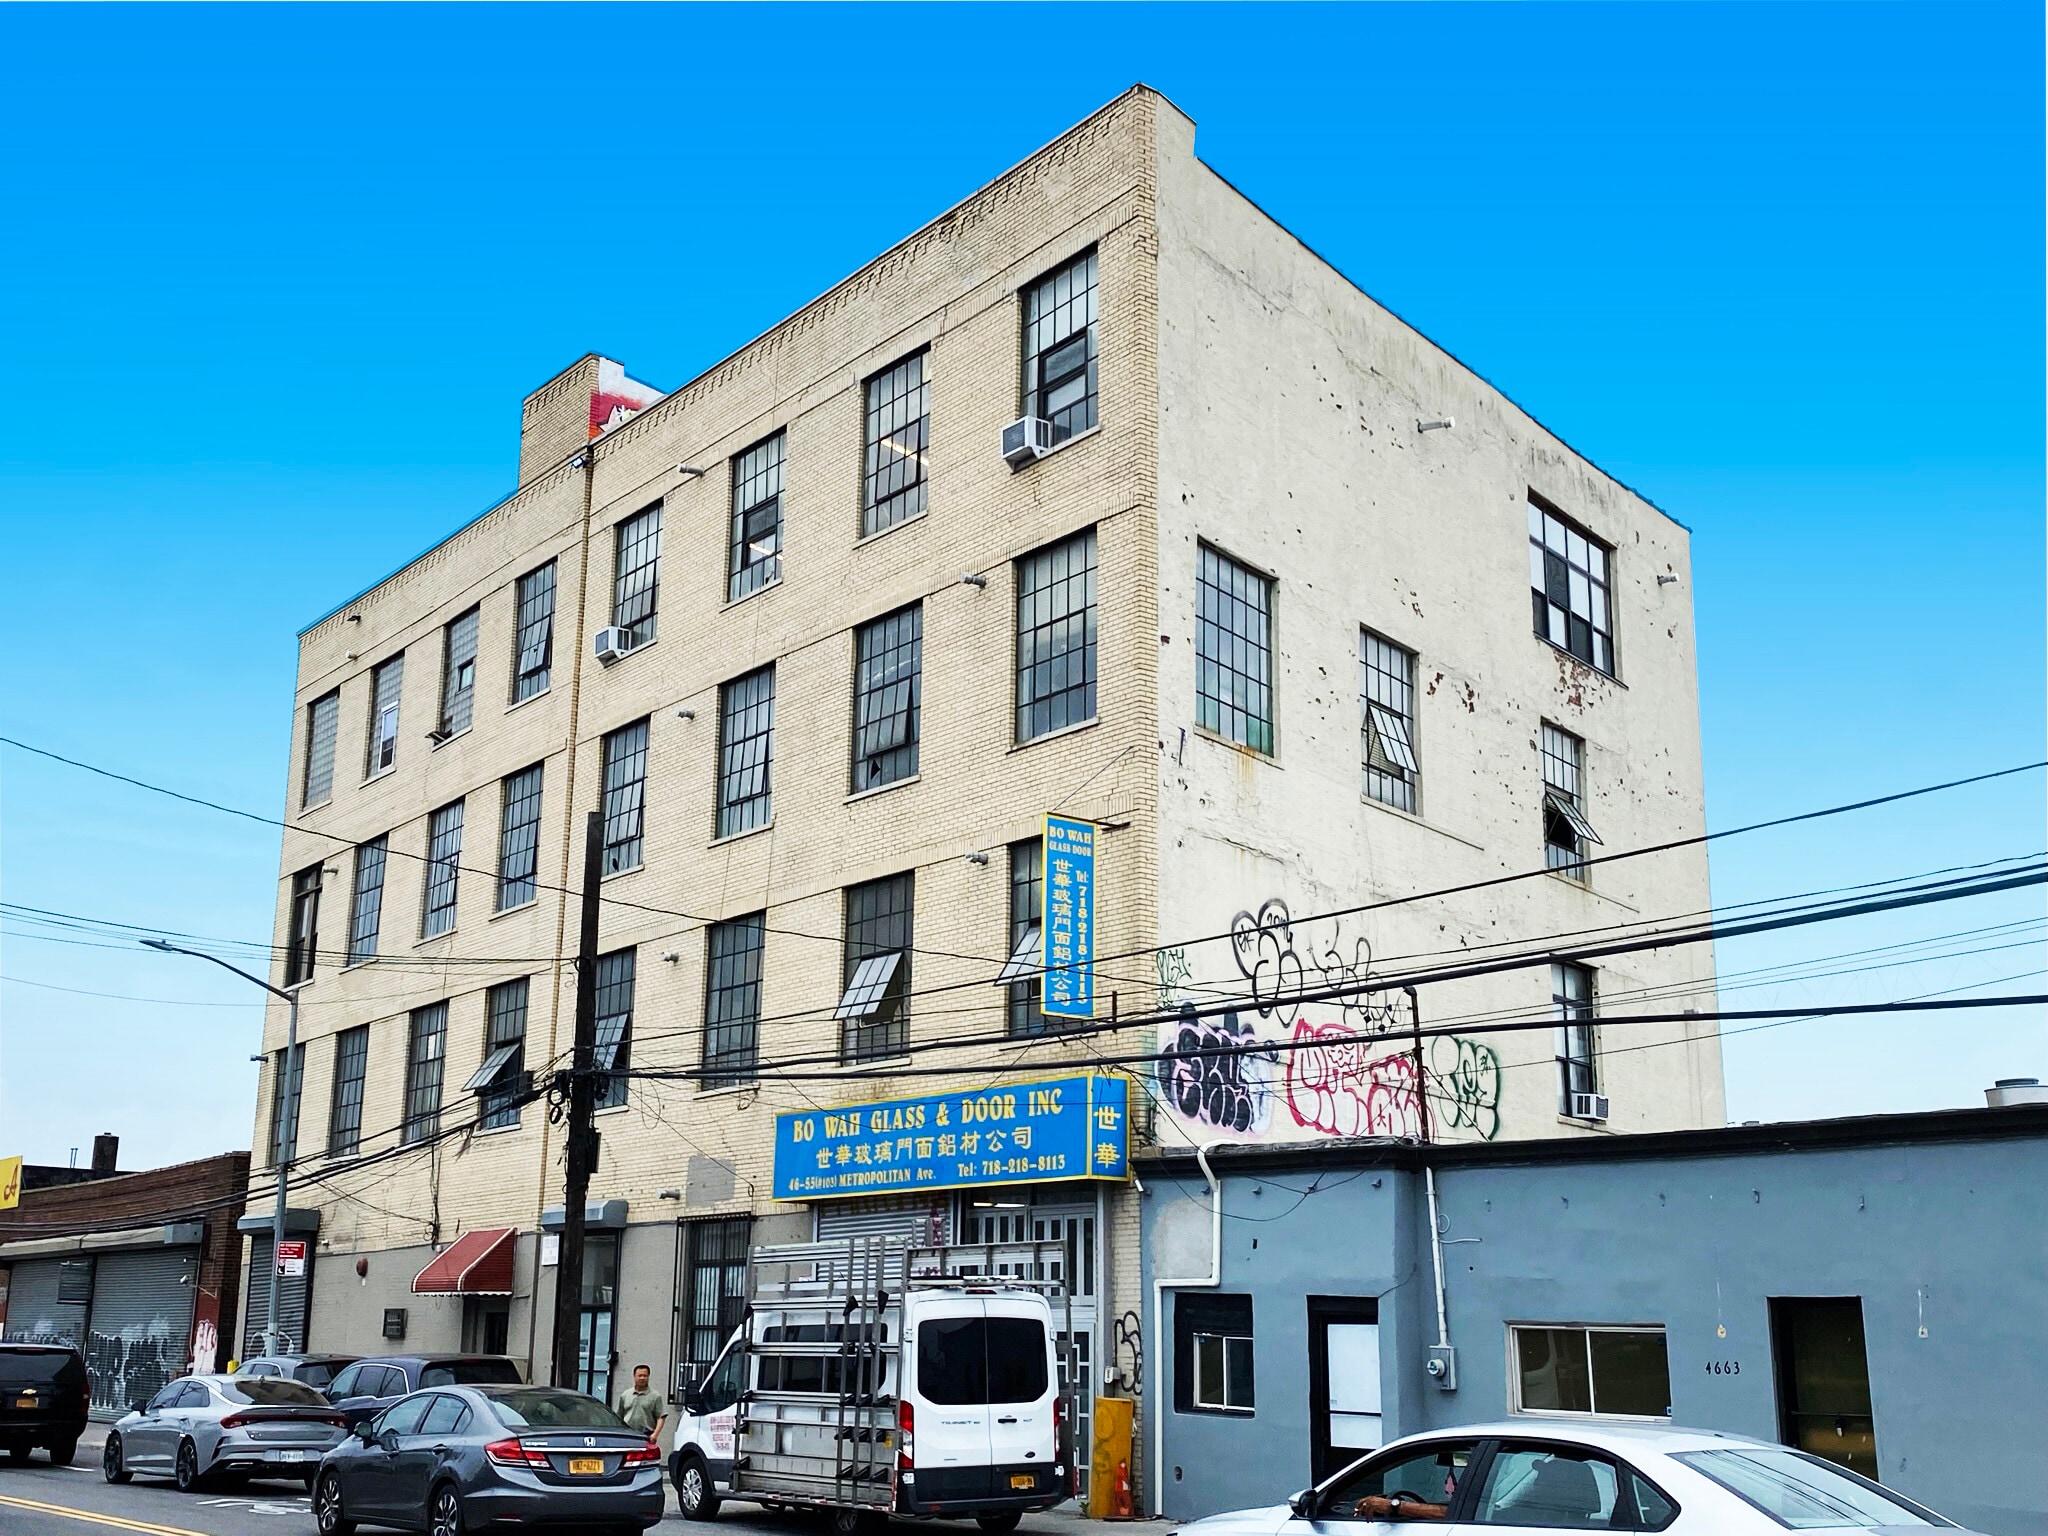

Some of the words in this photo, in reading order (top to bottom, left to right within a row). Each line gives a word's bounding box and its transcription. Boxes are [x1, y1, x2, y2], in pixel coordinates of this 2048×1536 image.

[1048, 840, 1071, 854] GLASS
[1072, 844, 1092, 857] DOOR
[1049, 825, 1065, 840] BO
[1067, 829, 1092, 845] WAH
[793, 1118, 815, 1143] BO
[824, 1112, 861, 1139] WAH
[870, 1105, 925, 1134] GLASS
[936, 1102, 950, 1127] &
[961, 1094, 1016, 1124] DOOR
[1028, 1087, 1064, 1117] INC
[816, 1125, 1032, 1169] 世華玻璃門面鋁材公司
[1093, 1105, 1122, 1169] 世華
[838, 1168, 911, 1187] METROPOLITAN
[957, 1162, 977, 1178] Tel:
[982, 1154, 1066, 1176] 718-218-8113
[1705, 1360, 1740, 1375] 4663
